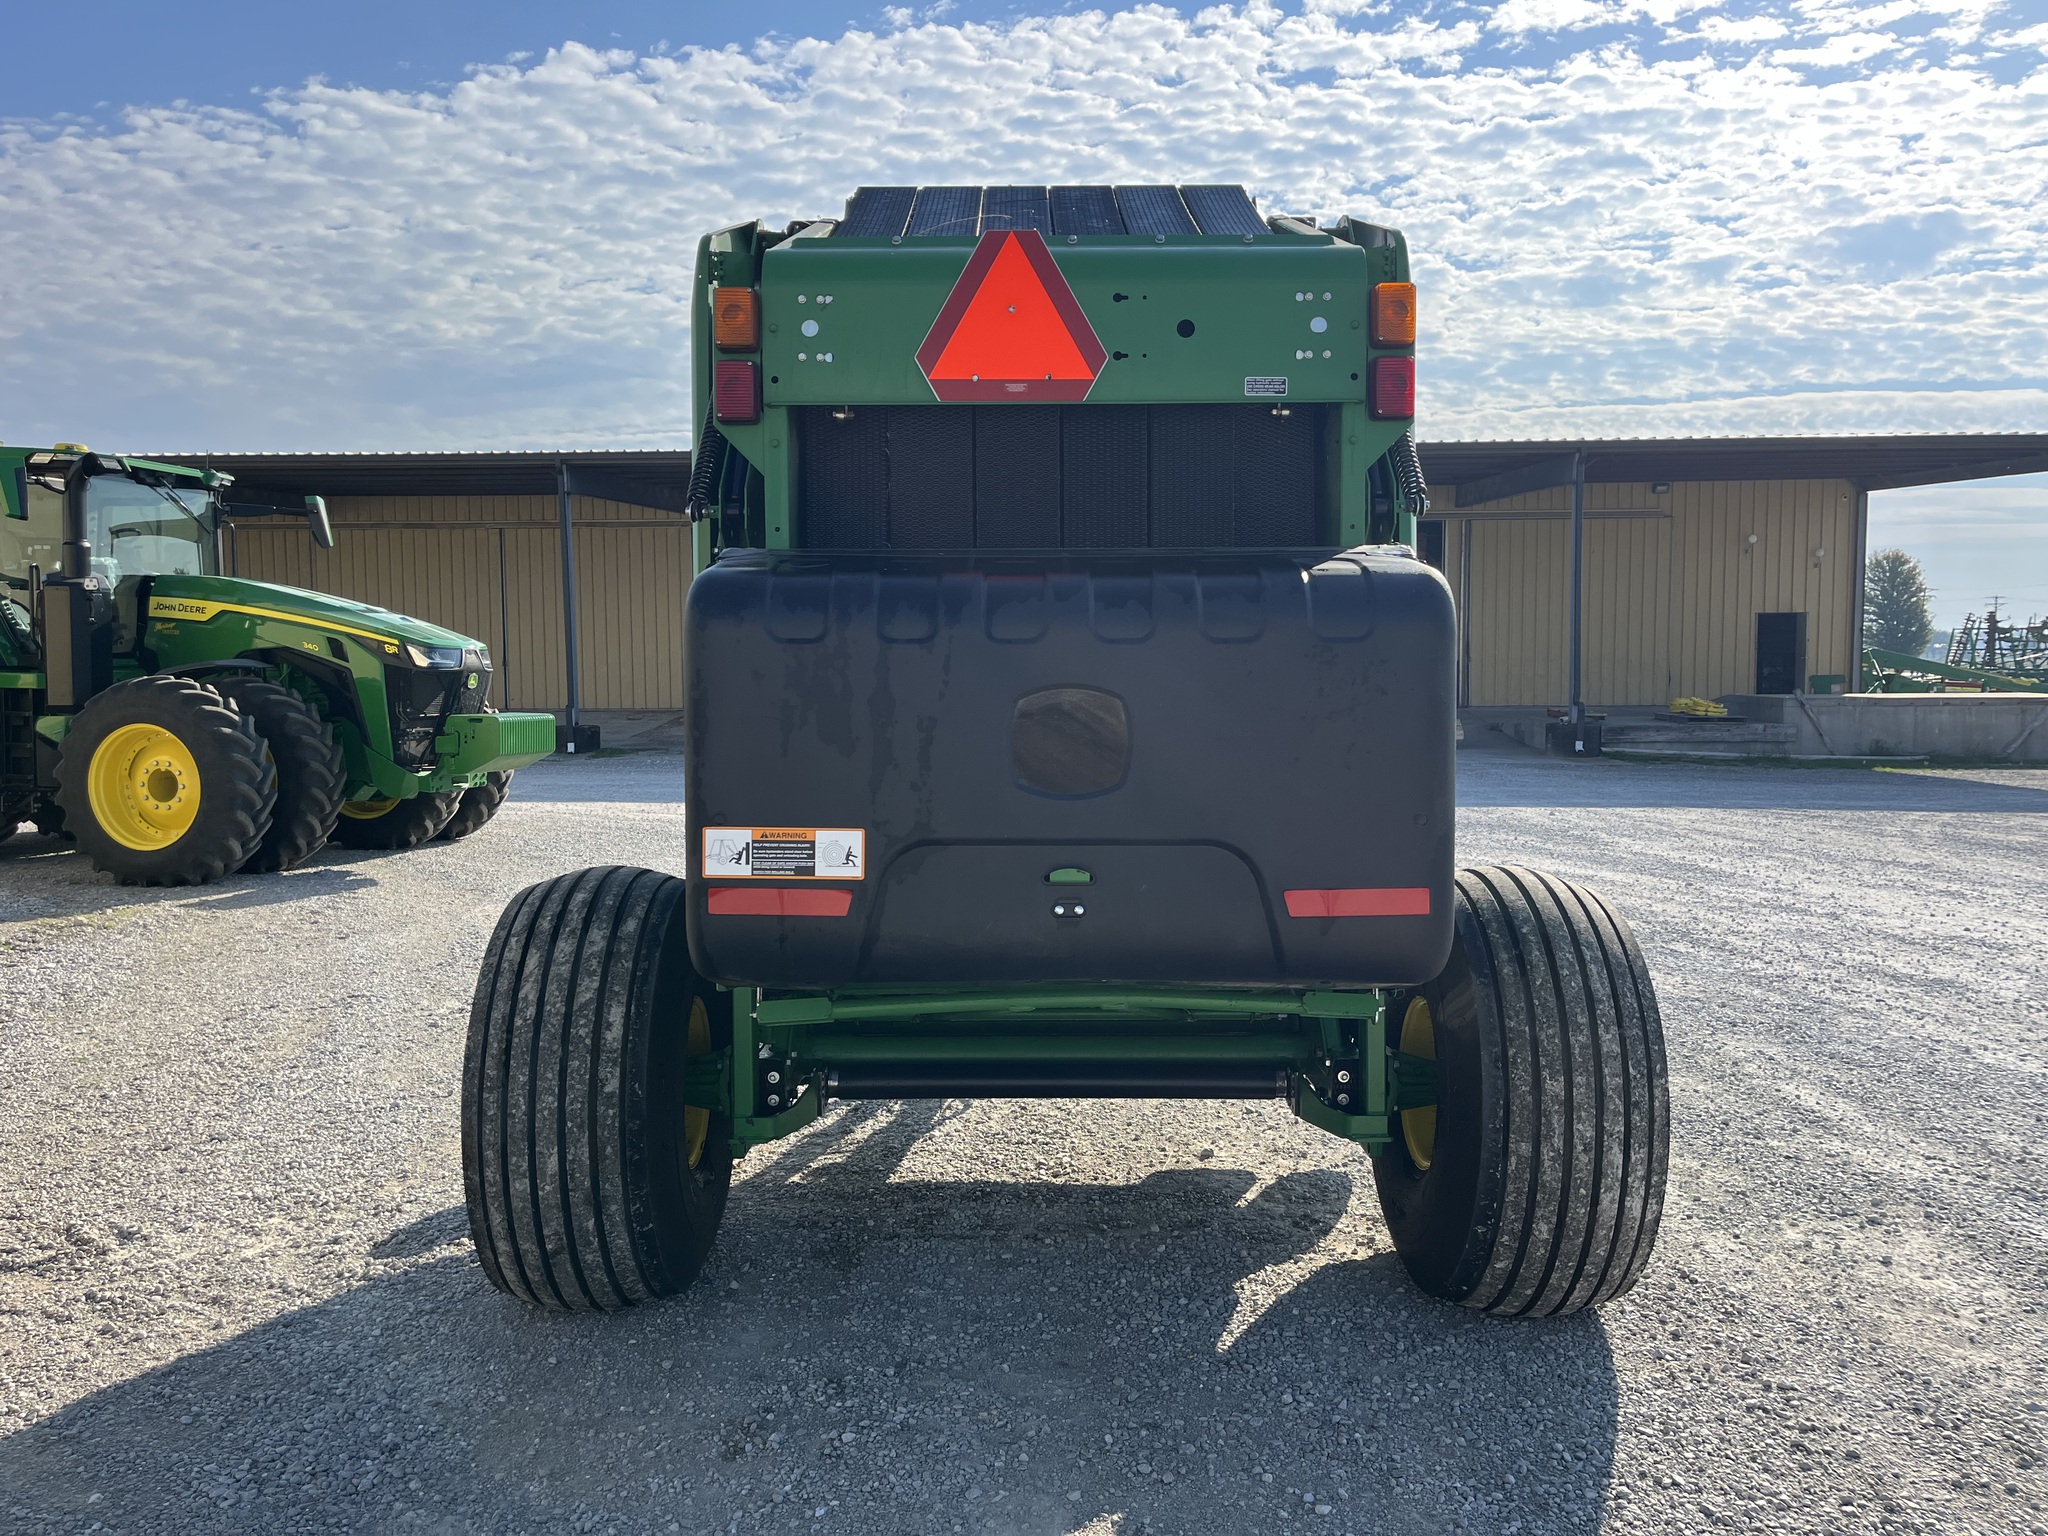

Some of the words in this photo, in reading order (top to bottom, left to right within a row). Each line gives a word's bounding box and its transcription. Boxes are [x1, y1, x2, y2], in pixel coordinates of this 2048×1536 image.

[154, 602, 176, 611] JOHN
[178, 603, 207, 614] DEERE
[302, 641, 319, 651] 340
[384, 644, 399, 654] 8R
